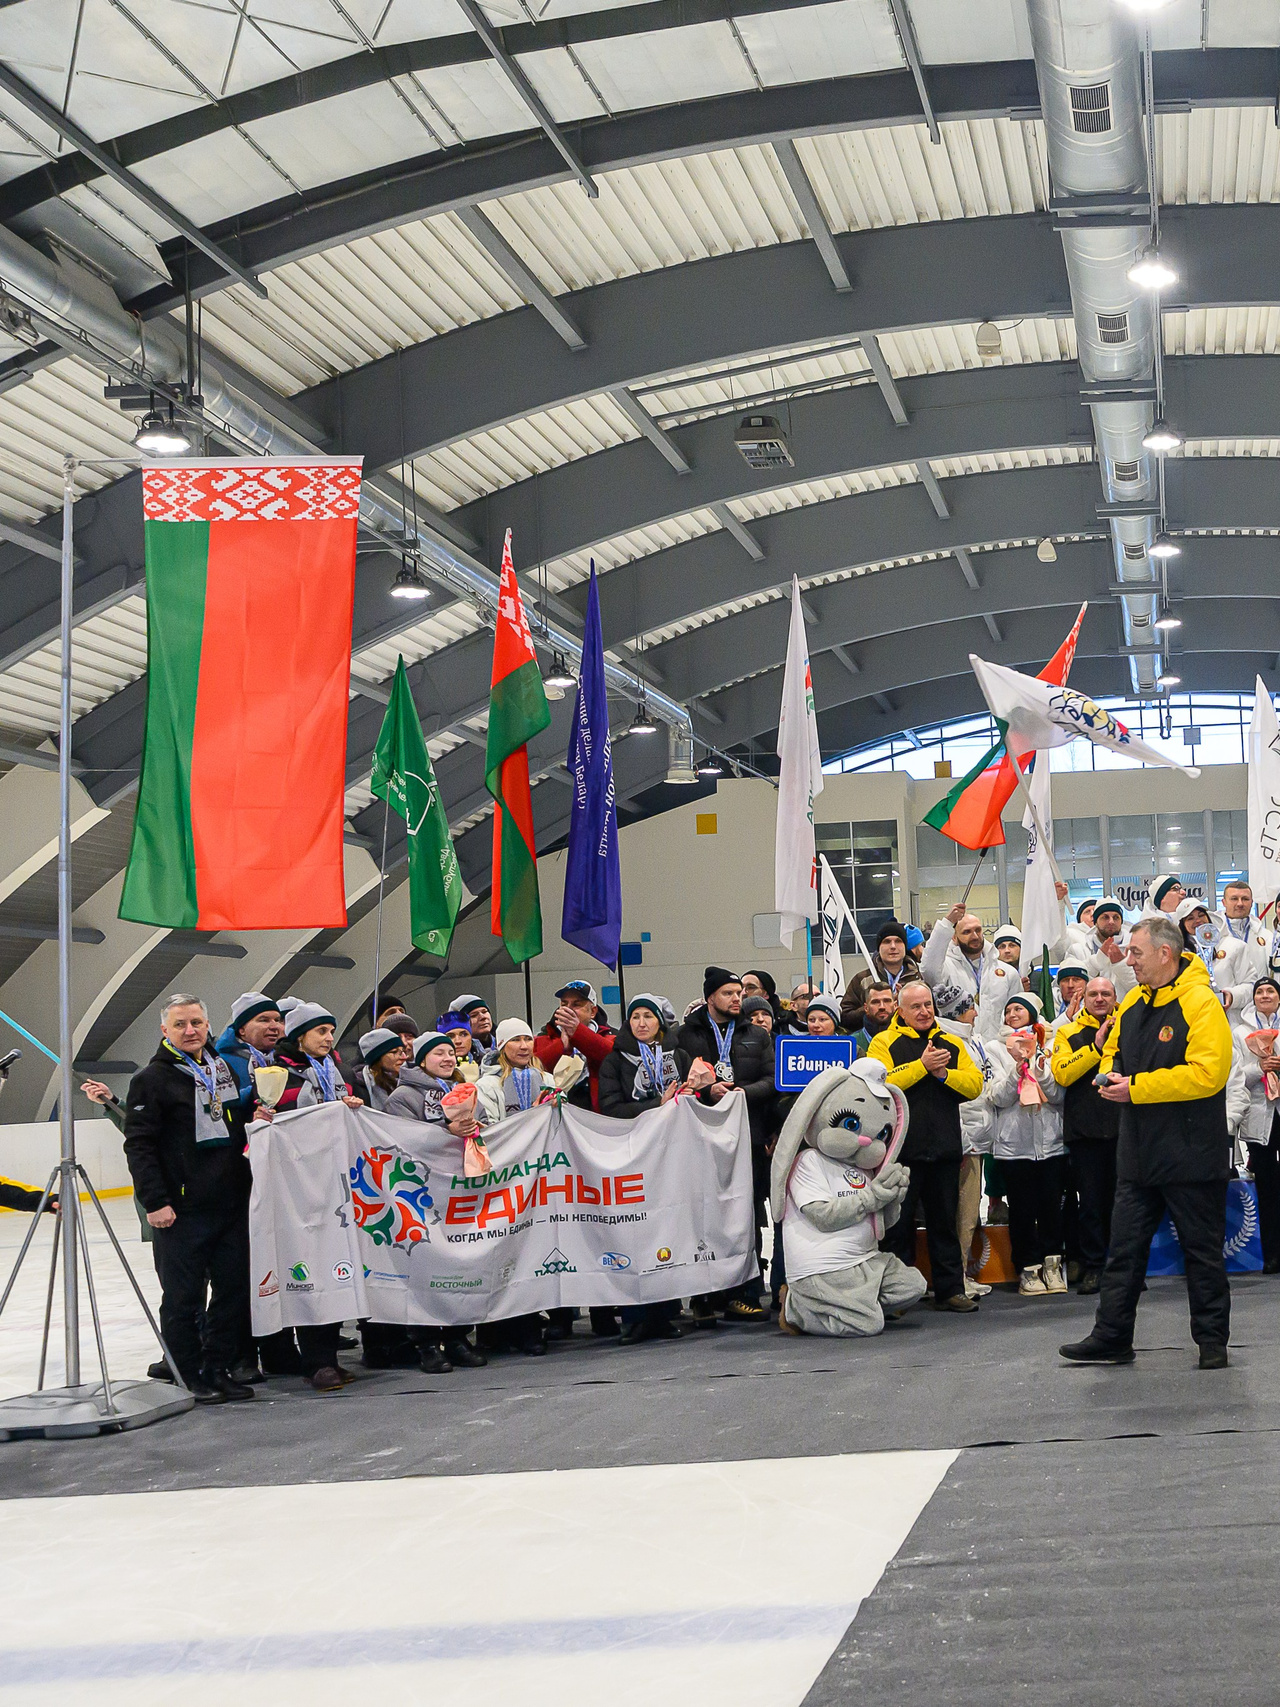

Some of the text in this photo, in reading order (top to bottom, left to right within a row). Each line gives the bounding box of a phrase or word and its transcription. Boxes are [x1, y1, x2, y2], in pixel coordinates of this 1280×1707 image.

[444, 1173, 646, 1229] ЕДИНЫЕ
[447, 1231, 484, 1243] КОГДА
[487, 1228, 508, 1240] МЫ
[509, 1218, 534, 1236] ЕДИНЫ
[549, 1213, 569, 1224] МЫ
[572, 1212, 648, 1226] НЕПОБЕДИМЫ!
[429, 1278, 483, 1289] ВОСТОЧНЫЙ
